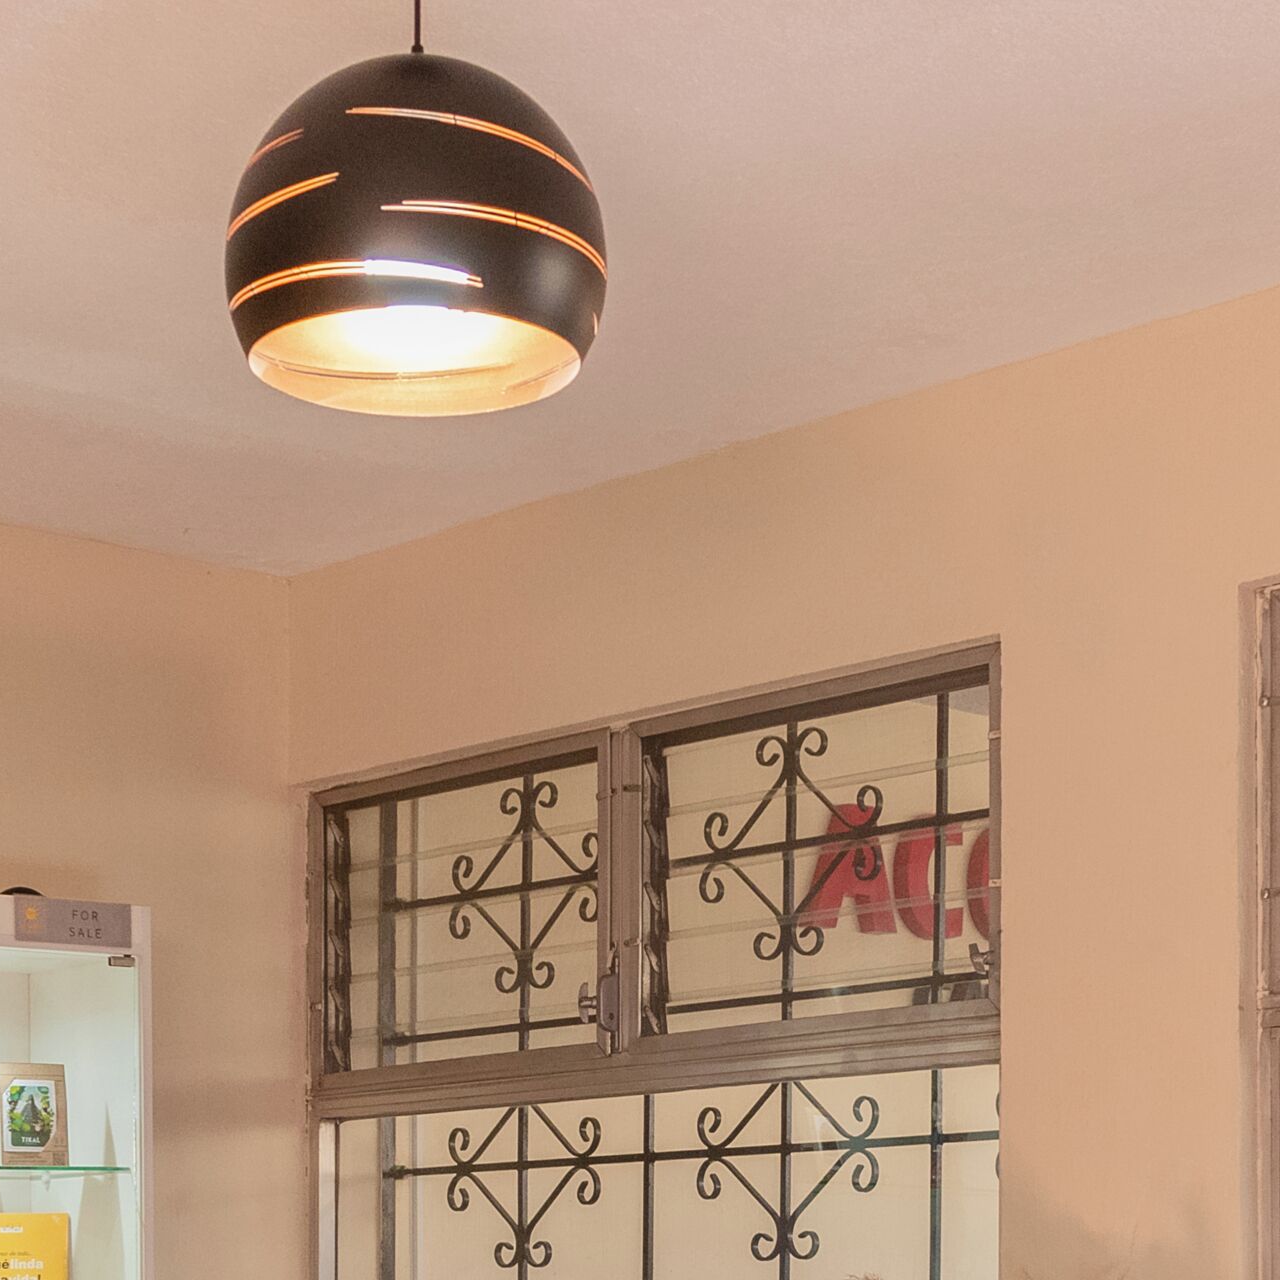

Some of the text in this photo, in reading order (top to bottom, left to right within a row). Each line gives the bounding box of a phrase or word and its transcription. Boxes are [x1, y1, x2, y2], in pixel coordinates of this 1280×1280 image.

[71, 909, 99, 921] FOR
[68, 927, 102, 939] SALE
[21, 1136, 41, 1144] TIKAL
